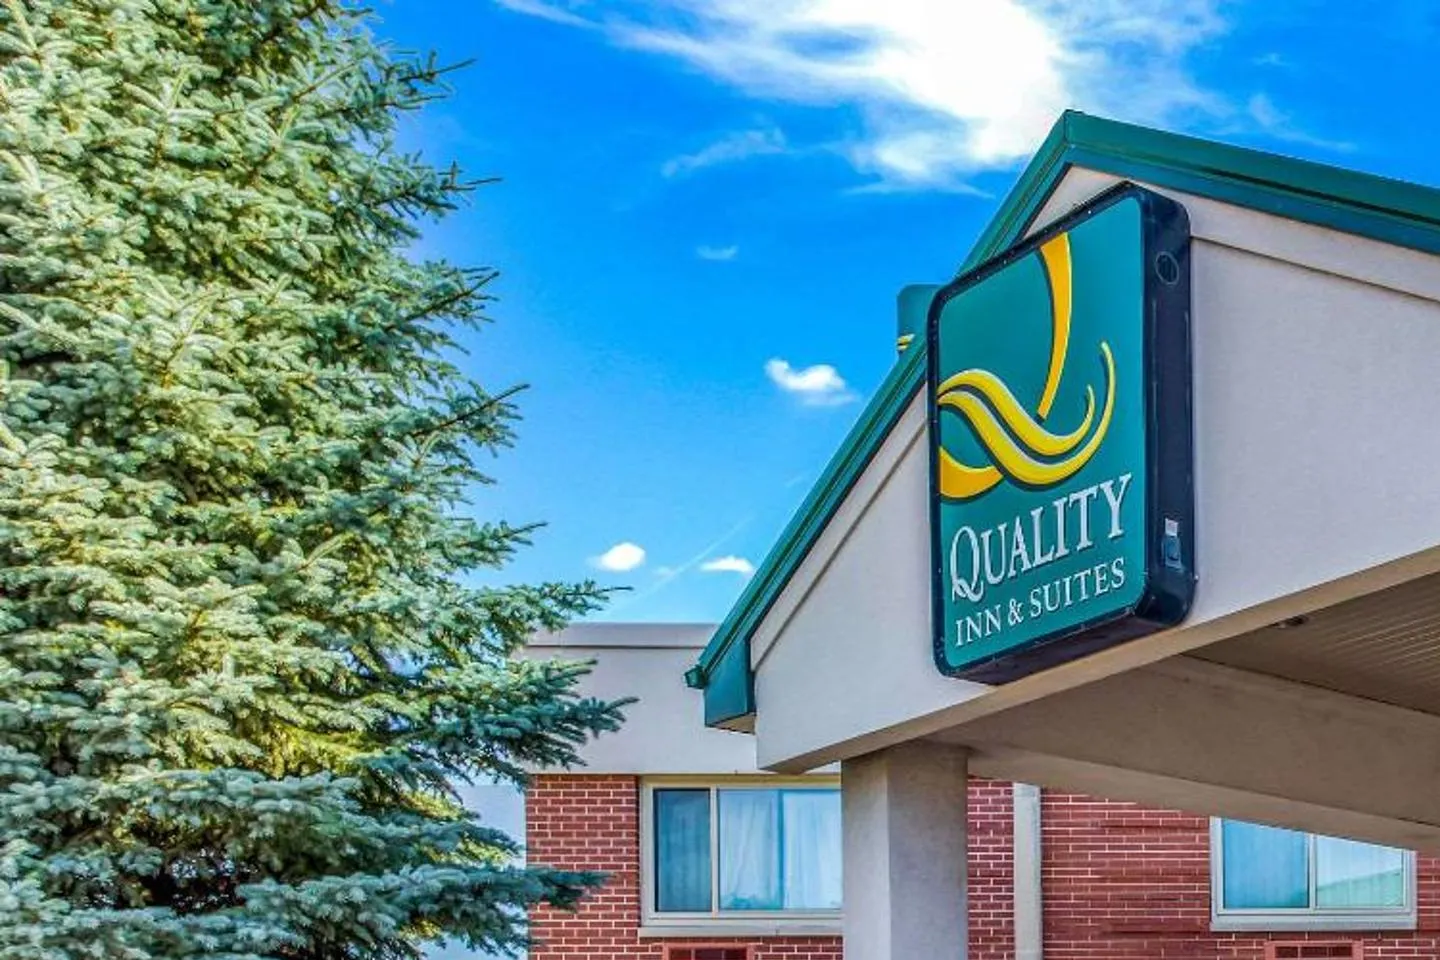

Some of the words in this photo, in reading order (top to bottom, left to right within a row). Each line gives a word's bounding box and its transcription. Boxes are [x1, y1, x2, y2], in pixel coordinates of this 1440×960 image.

[950, 472, 1133, 603] QUALITY
[954, 602, 1002, 647] INN
[1007, 598, 1025, 626] &
[1029, 557, 1126, 618] SUITES
